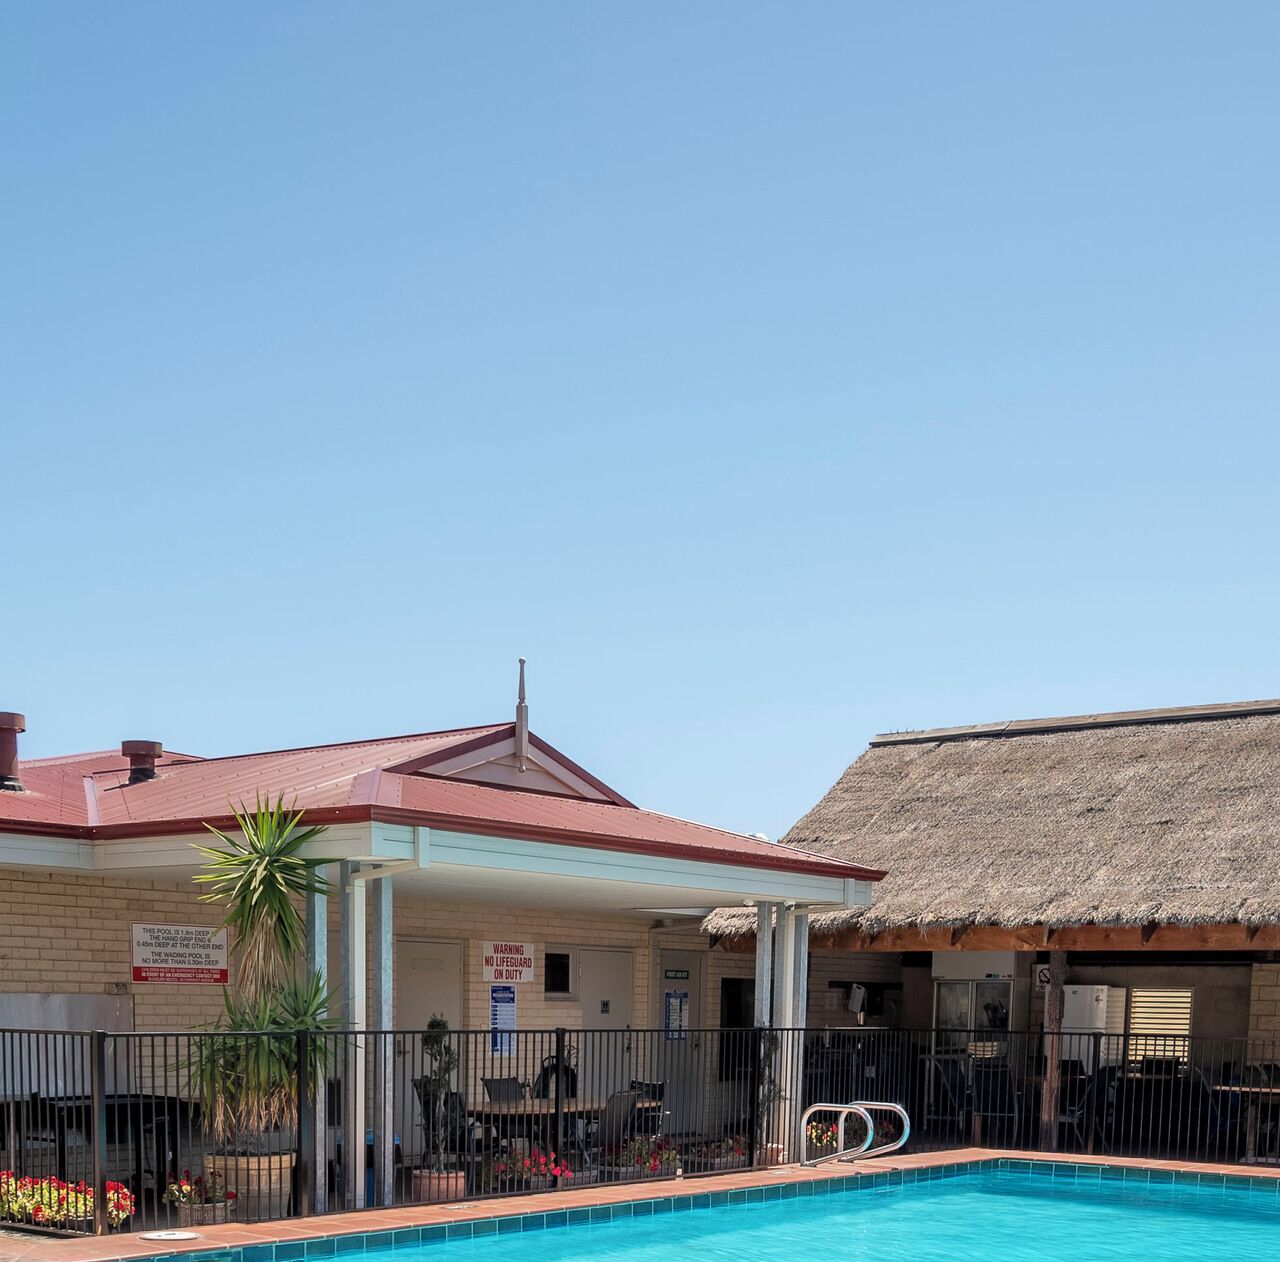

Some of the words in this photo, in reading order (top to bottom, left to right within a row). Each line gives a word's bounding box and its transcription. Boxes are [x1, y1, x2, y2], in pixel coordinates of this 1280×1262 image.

[492, 943, 524, 956] WARNING
[485, 957, 494, 967] NO
[496, 957, 532, 969] LIFEGUARD
[494, 969, 504, 980] ON
[505, 969, 523, 980] DUTY
